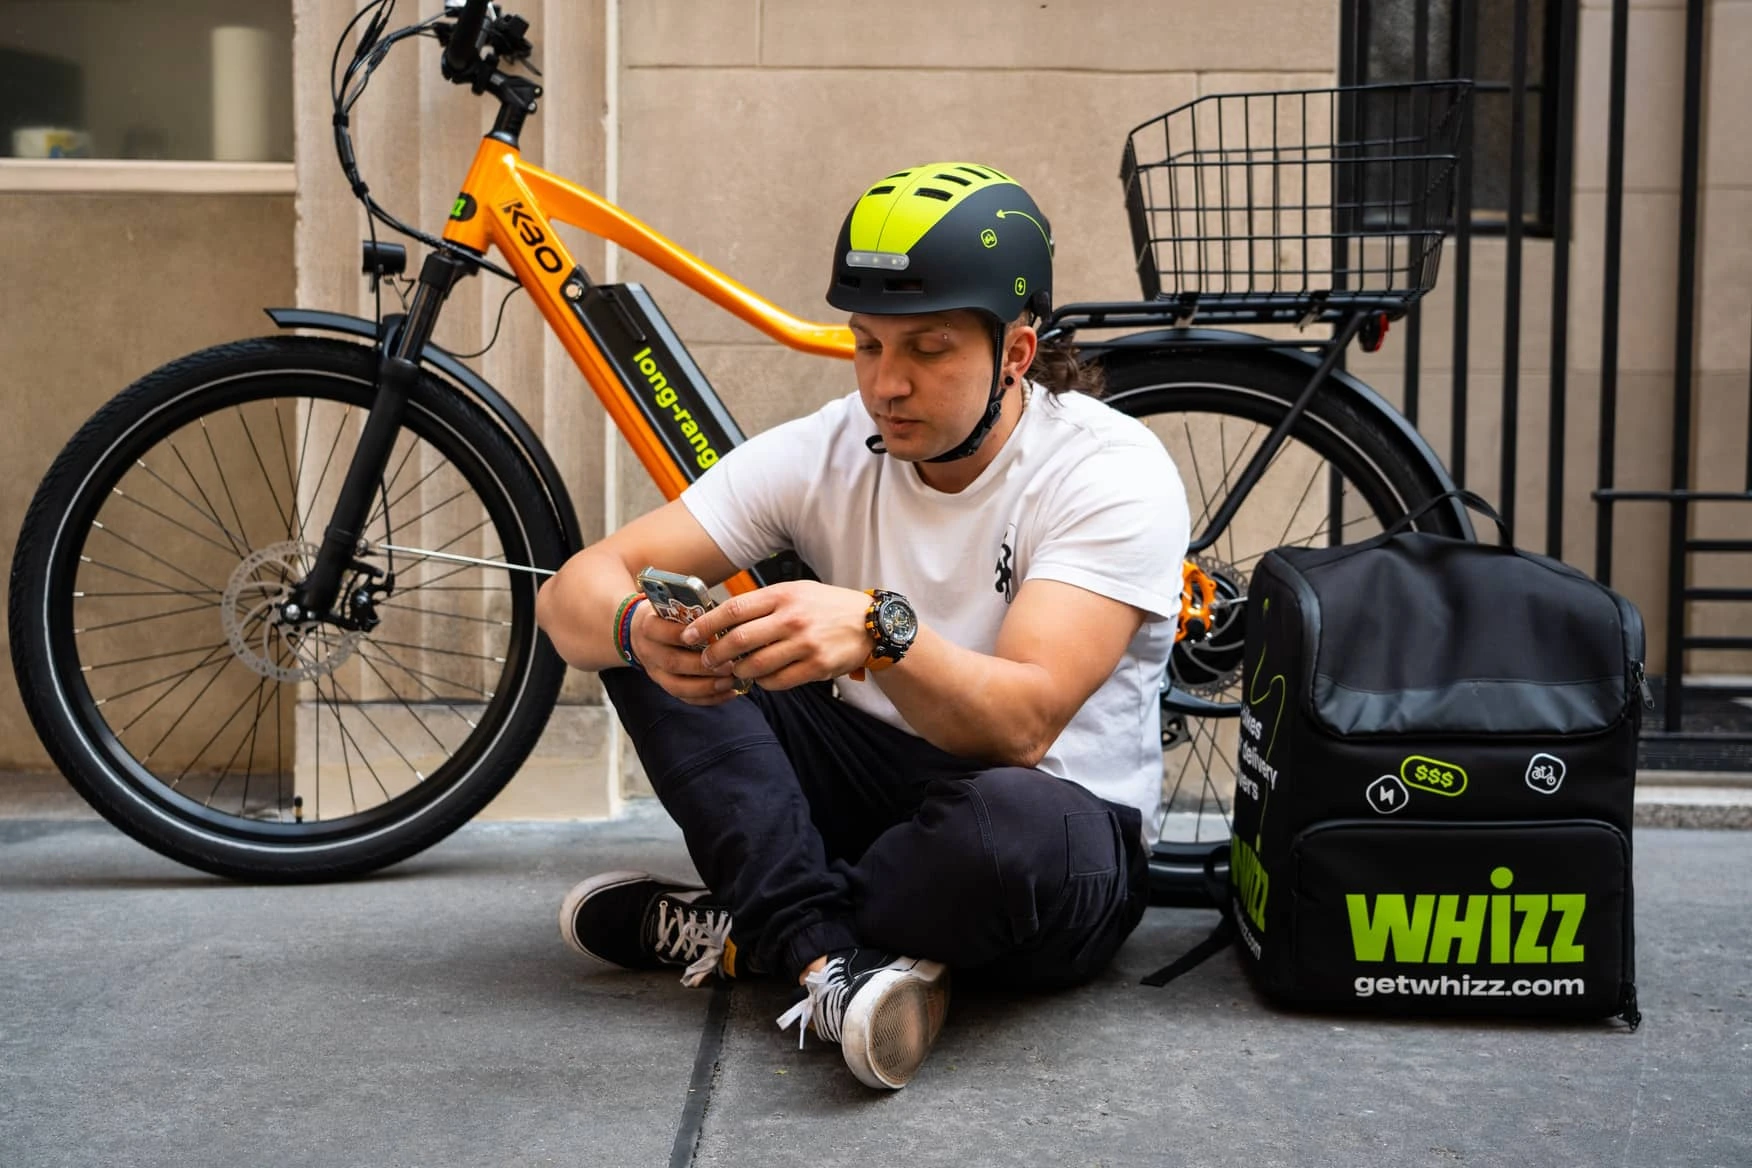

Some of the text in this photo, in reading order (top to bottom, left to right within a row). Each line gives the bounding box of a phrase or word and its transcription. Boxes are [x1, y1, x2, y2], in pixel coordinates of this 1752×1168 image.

[500, 199, 563, 273] K30
[633, 347, 719, 469] long-rang
[1354, 974, 1585, 997] getwhizz.com
